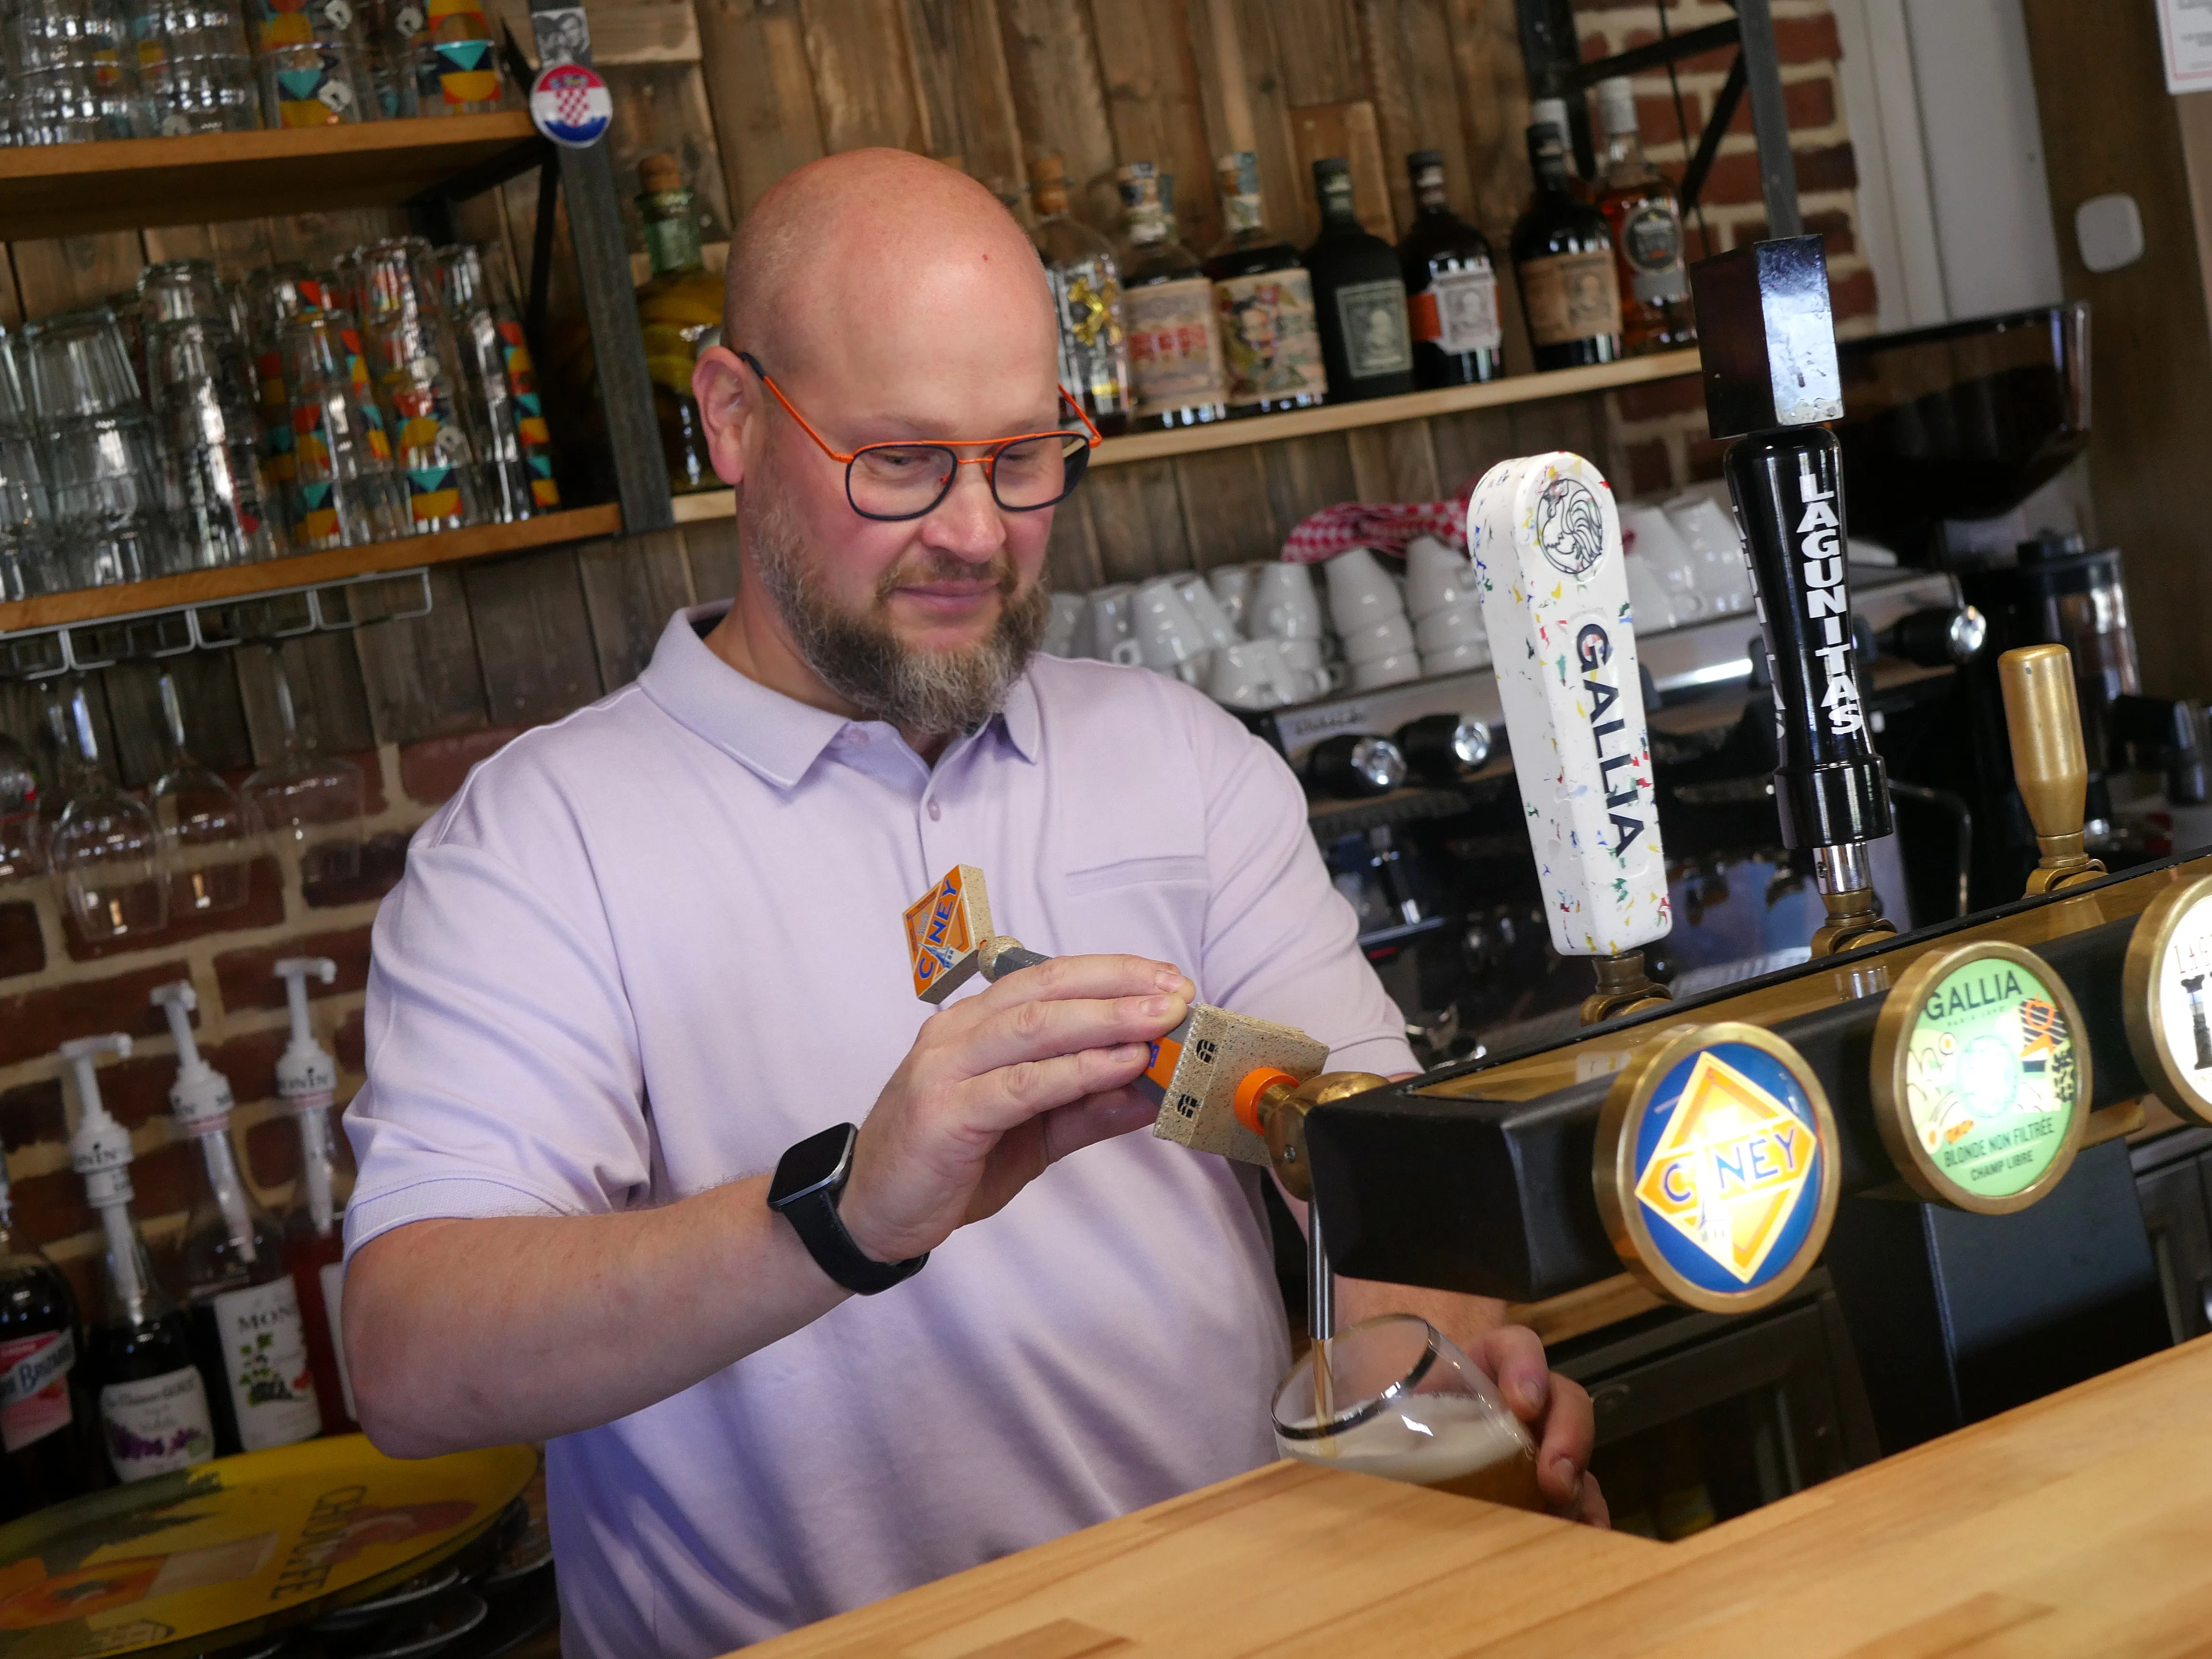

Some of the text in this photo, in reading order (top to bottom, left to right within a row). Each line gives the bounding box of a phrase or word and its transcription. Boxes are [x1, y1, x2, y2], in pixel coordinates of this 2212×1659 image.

[1796, 473, 1862, 735] LAGUNITAS
[1577, 623, 1644, 857] GALLIA
[1925, 970, 2022, 1021] GALLIA
[1945, 1117, 2054, 1167] BLONDE NON FILTRÉE
[1972, 1159, 2004, 1181] CHAMP
